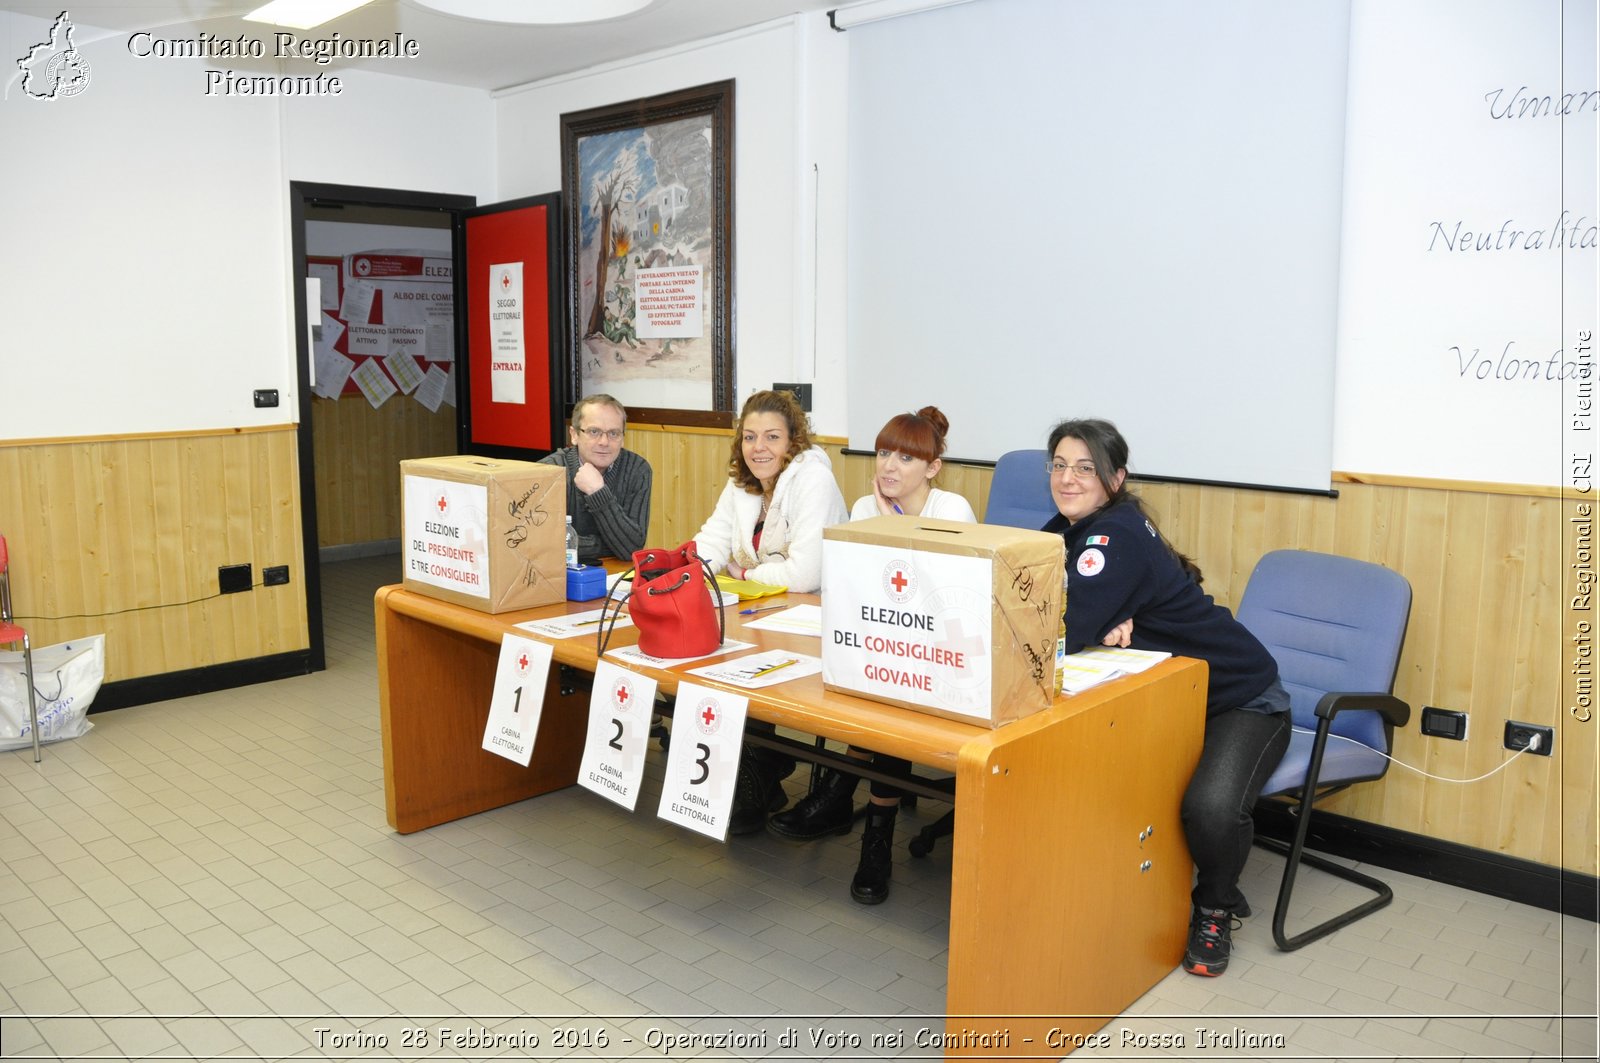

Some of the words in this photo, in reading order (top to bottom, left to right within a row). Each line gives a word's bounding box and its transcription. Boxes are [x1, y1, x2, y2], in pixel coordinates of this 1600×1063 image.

[393, 292, 414, 300] ALBO
[416, 292, 430, 300] DEL
[496, 298, 517, 308] SEGGIO
[492, 312, 521, 321] ELETTORALE
[356, 337, 378, 345] ATTIVO
[392, 337, 417, 345] PASSIVO
[492, 362, 522, 372] ENTRATA
[1449, 341, 1600, 381] Volontar
[425, 521, 460, 539] ELEZIONE
[413, 540, 426, 552] DEL
[428, 542, 474, 563] PRESIDENTE
[412, 559, 416, 570] E
[416, 560, 429, 574] TRE
[430, 564, 479, 586] CONSIGLIERI
[861, 605, 934, 631] ELEZIONE
[834, 630, 862, 648] DEL
[864, 635, 965, 668] CONSIGLIERE
[864, 664, 932, 692] GIOVANE
[514, 686, 522, 713] 1
[501, 726, 521, 740] CABINA
[608, 718, 624, 751] 2
[492, 736, 524, 754] ELETTORALE
[600, 762, 623, 780] CABINA
[690, 742, 711, 786] 3
[589, 772, 628, 796] ELETTORALE
[682, 792, 710, 809] CABINA
[671, 802, 716, 826] ELETTORALE
